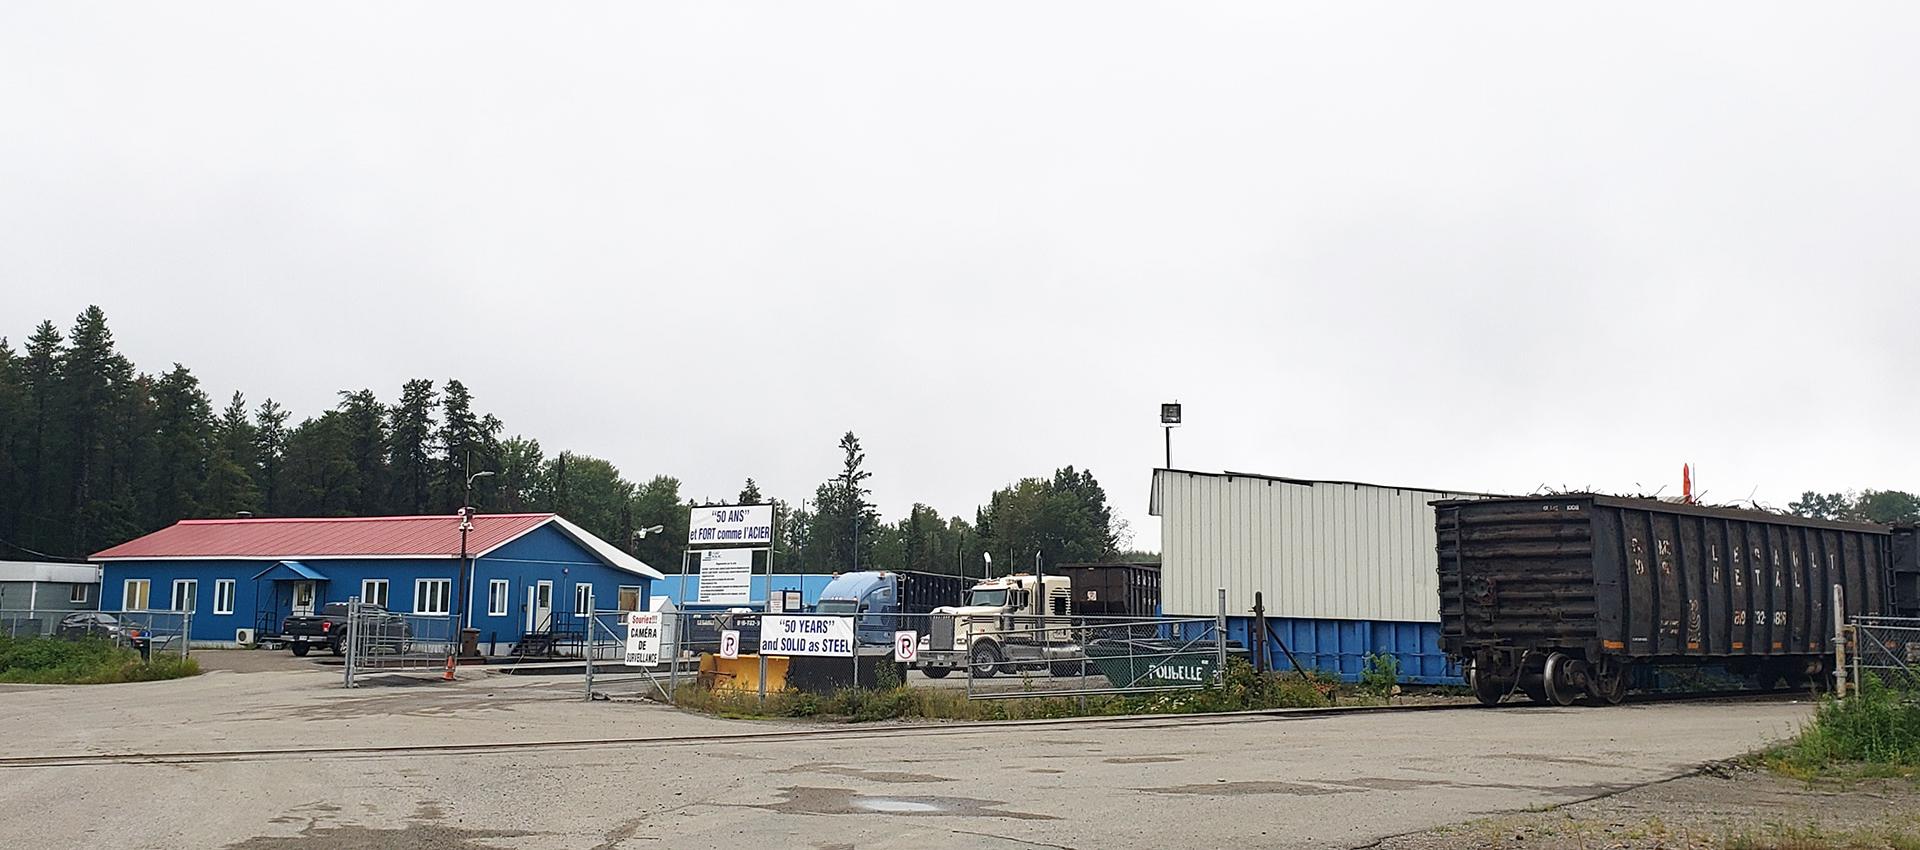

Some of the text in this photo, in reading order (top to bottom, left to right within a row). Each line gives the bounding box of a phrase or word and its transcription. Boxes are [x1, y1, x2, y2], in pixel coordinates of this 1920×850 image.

[712, 509, 750, 523] "50 ANS"
[690, 526, 770, 540] et FORT comme l'ACIER
[630, 626, 658, 638] CAMÉRA
[779, 620, 835, 634] "50 YEARS"
[638, 640, 647, 651] DE
[762, 637, 851, 653] and SOLID as STEEL
[626, 652, 658, 663] SURVEILLANCE
